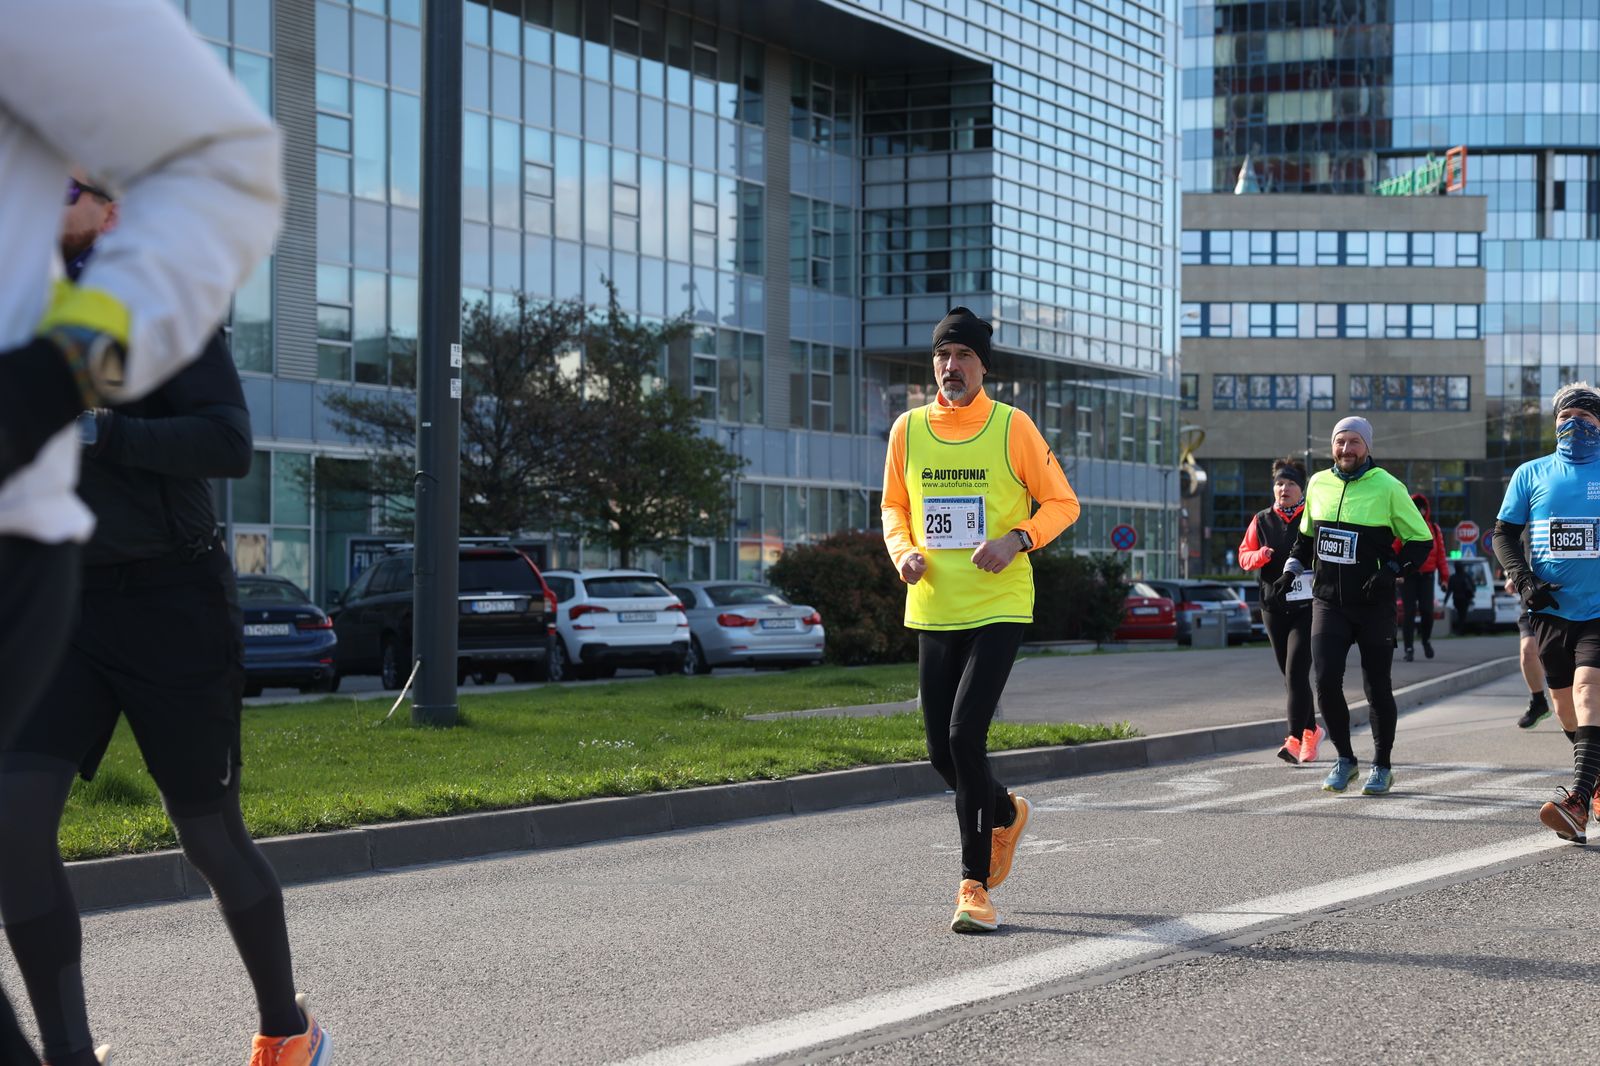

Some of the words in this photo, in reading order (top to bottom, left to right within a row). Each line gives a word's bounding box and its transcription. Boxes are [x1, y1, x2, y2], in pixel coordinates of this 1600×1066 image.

[934, 469, 986, 480] AUTOFUNIA
[926, 513, 951, 534] 235
[1458, 528, 1476, 537] STOP
[1551, 532, 1583, 547] 13625
[1320, 539, 1343, 554] 10991
